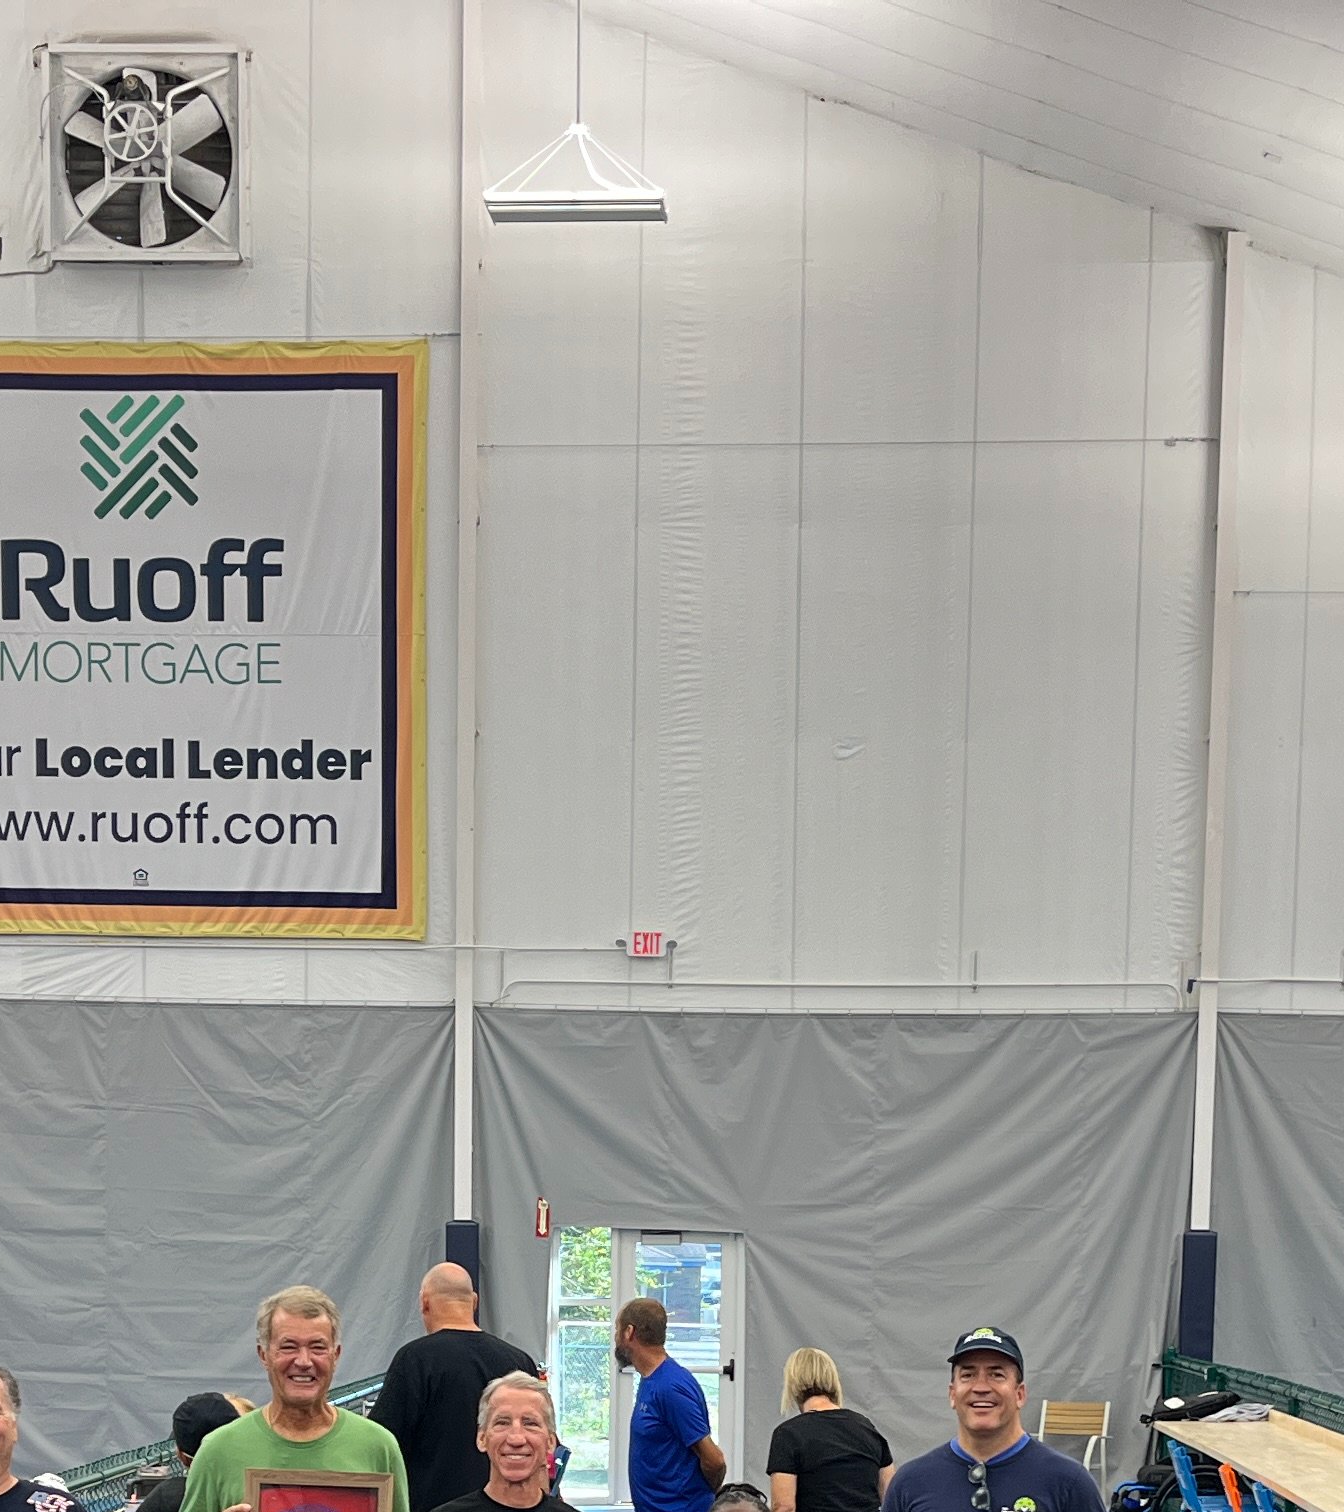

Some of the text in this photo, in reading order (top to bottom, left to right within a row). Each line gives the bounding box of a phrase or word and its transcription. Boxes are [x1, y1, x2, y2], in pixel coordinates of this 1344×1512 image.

[0, 537, 284, 622] Ruoff
[0, 640, 282, 685] MORTGAGE
[35, 737, 174, 778] Local
[187, 738, 372, 781] Lender
[632, 931, 662, 955] EXIT
